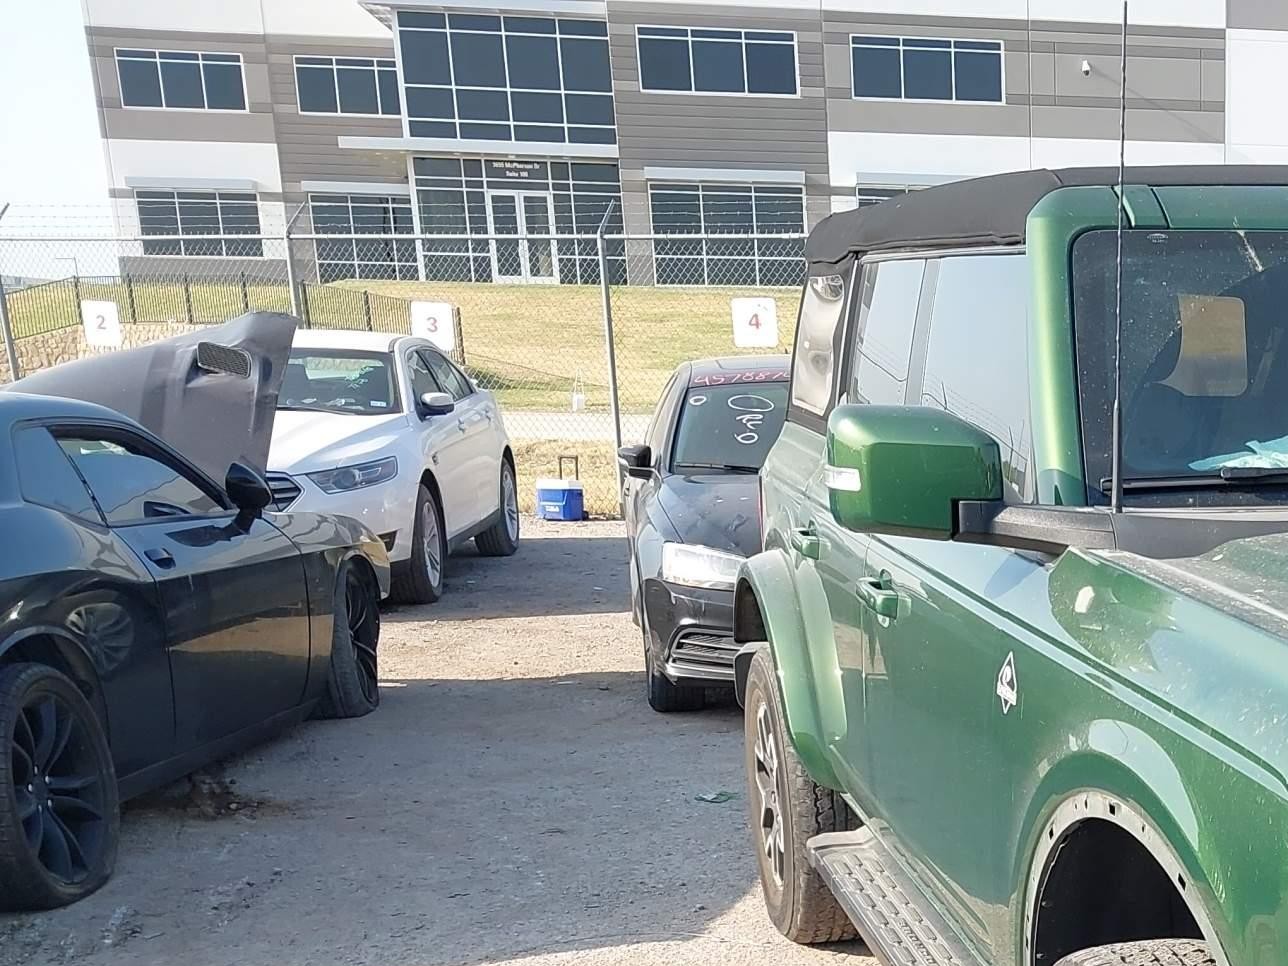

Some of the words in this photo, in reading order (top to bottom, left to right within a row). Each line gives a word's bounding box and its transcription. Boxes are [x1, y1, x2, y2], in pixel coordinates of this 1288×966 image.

[96, 314, 107, 330] 2
[427, 316, 438, 333] 3
[749, 313, 761, 329] 4
